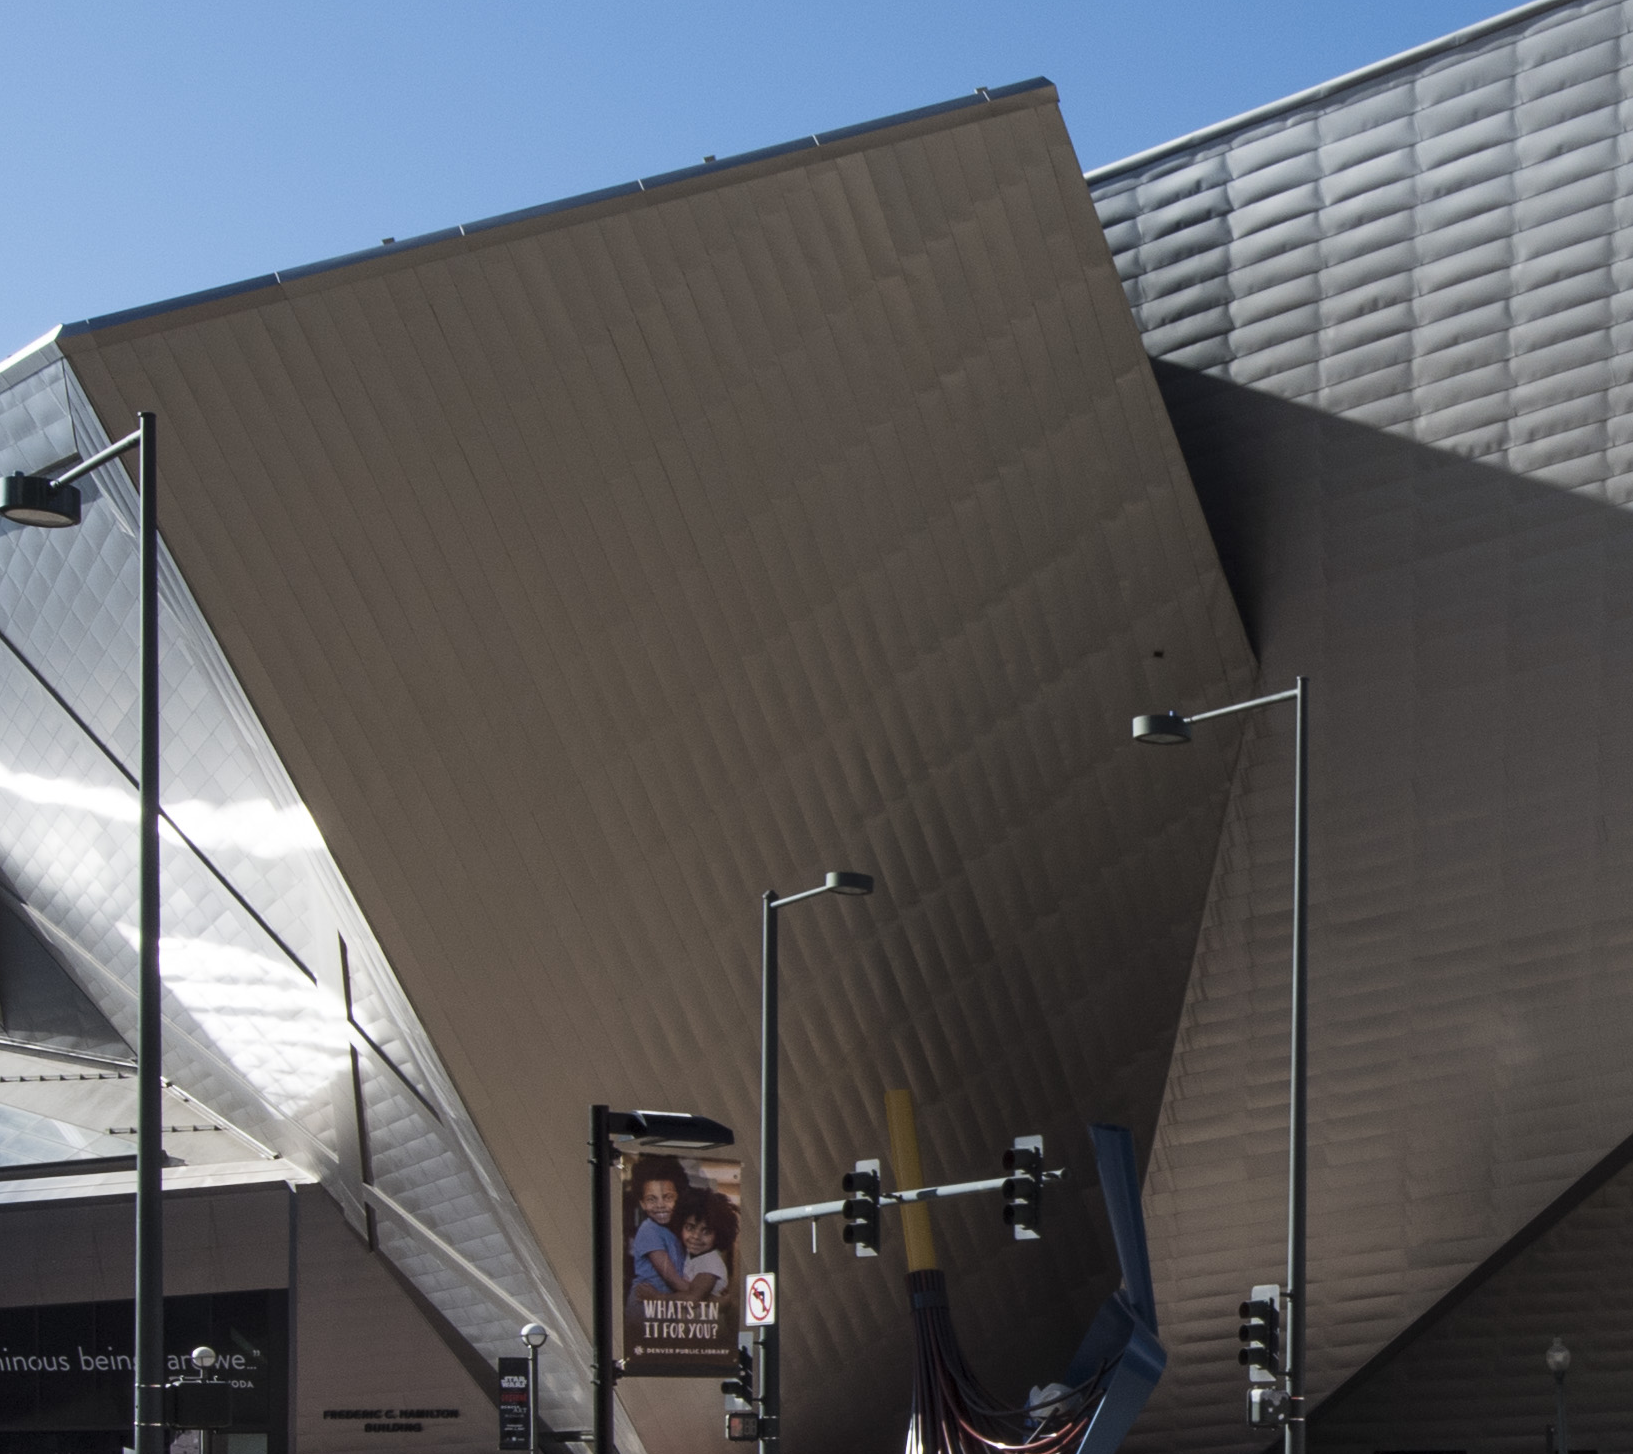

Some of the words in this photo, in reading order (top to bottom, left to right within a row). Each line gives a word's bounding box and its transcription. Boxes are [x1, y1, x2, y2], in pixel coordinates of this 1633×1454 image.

[643, 1300, 694, 1320] WHAT'S
[699, 1302, 719, 1320] IN
[644, 1322, 659, 1338] IT
[663, 1322, 686, 1339] FOR
[688, 1324, 719, 1339] YOU?
[78, 1346, 137, 1371] bein
[227, 1380, 254, 1388] ODA
[323, 1409, 382, 1420] FREDERIC
[399, 1409, 459, 1419] HAMILTON
[364, 1423, 423, 1433] BUILDING
